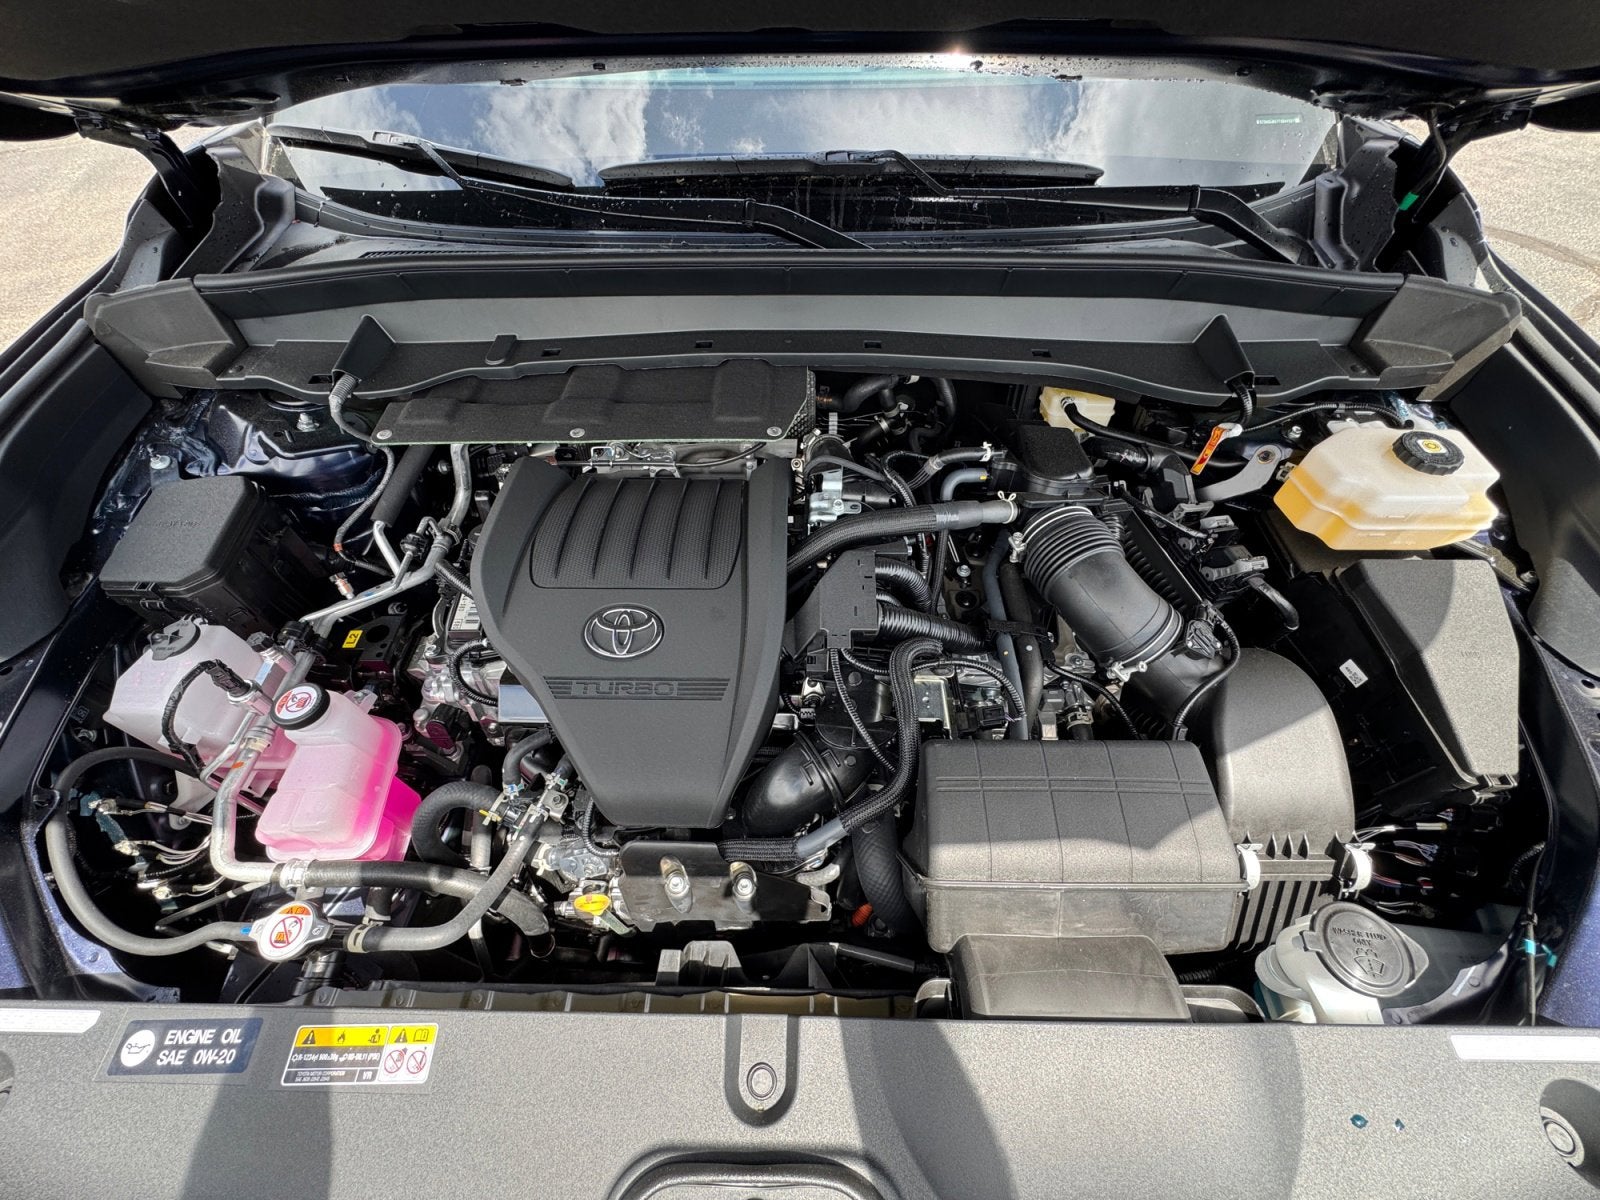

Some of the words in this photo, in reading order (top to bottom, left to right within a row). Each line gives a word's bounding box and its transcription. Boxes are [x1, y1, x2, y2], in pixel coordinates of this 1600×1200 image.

[345, 633, 358, 645] L2
[575, 681, 675, 696] TURBO
[164, 1029, 216, 1045] ENGINE
[221, 1028, 243, 1044] OIL
[156, 1049, 188, 1065] SAE
[192, 1048, 236, 1065] 0W-20
